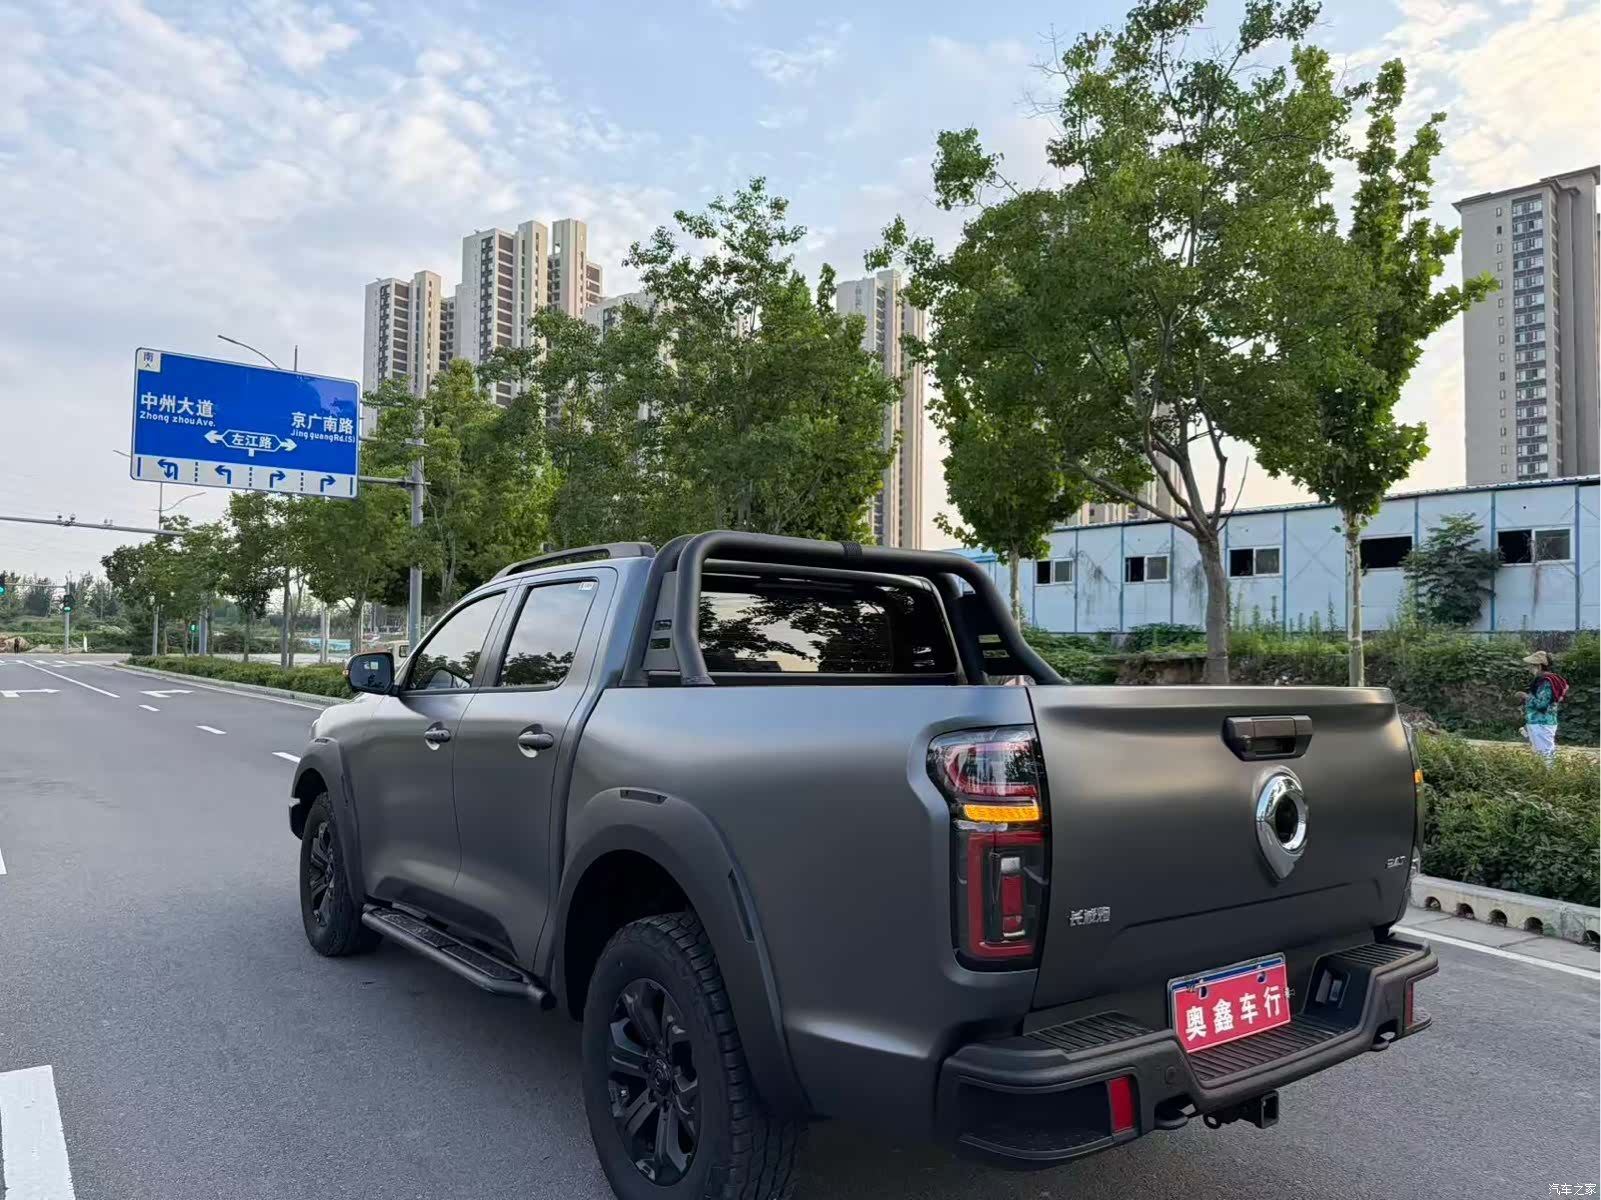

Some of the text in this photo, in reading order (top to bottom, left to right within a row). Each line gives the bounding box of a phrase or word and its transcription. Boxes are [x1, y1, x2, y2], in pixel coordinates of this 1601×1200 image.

[141, 392, 214, 418] 中州大道
[291, 411, 354, 435] 京广南路
[231, 432, 272, 449] 左江路
[1185, 985, 1281, 1042] 奥鑫车行
